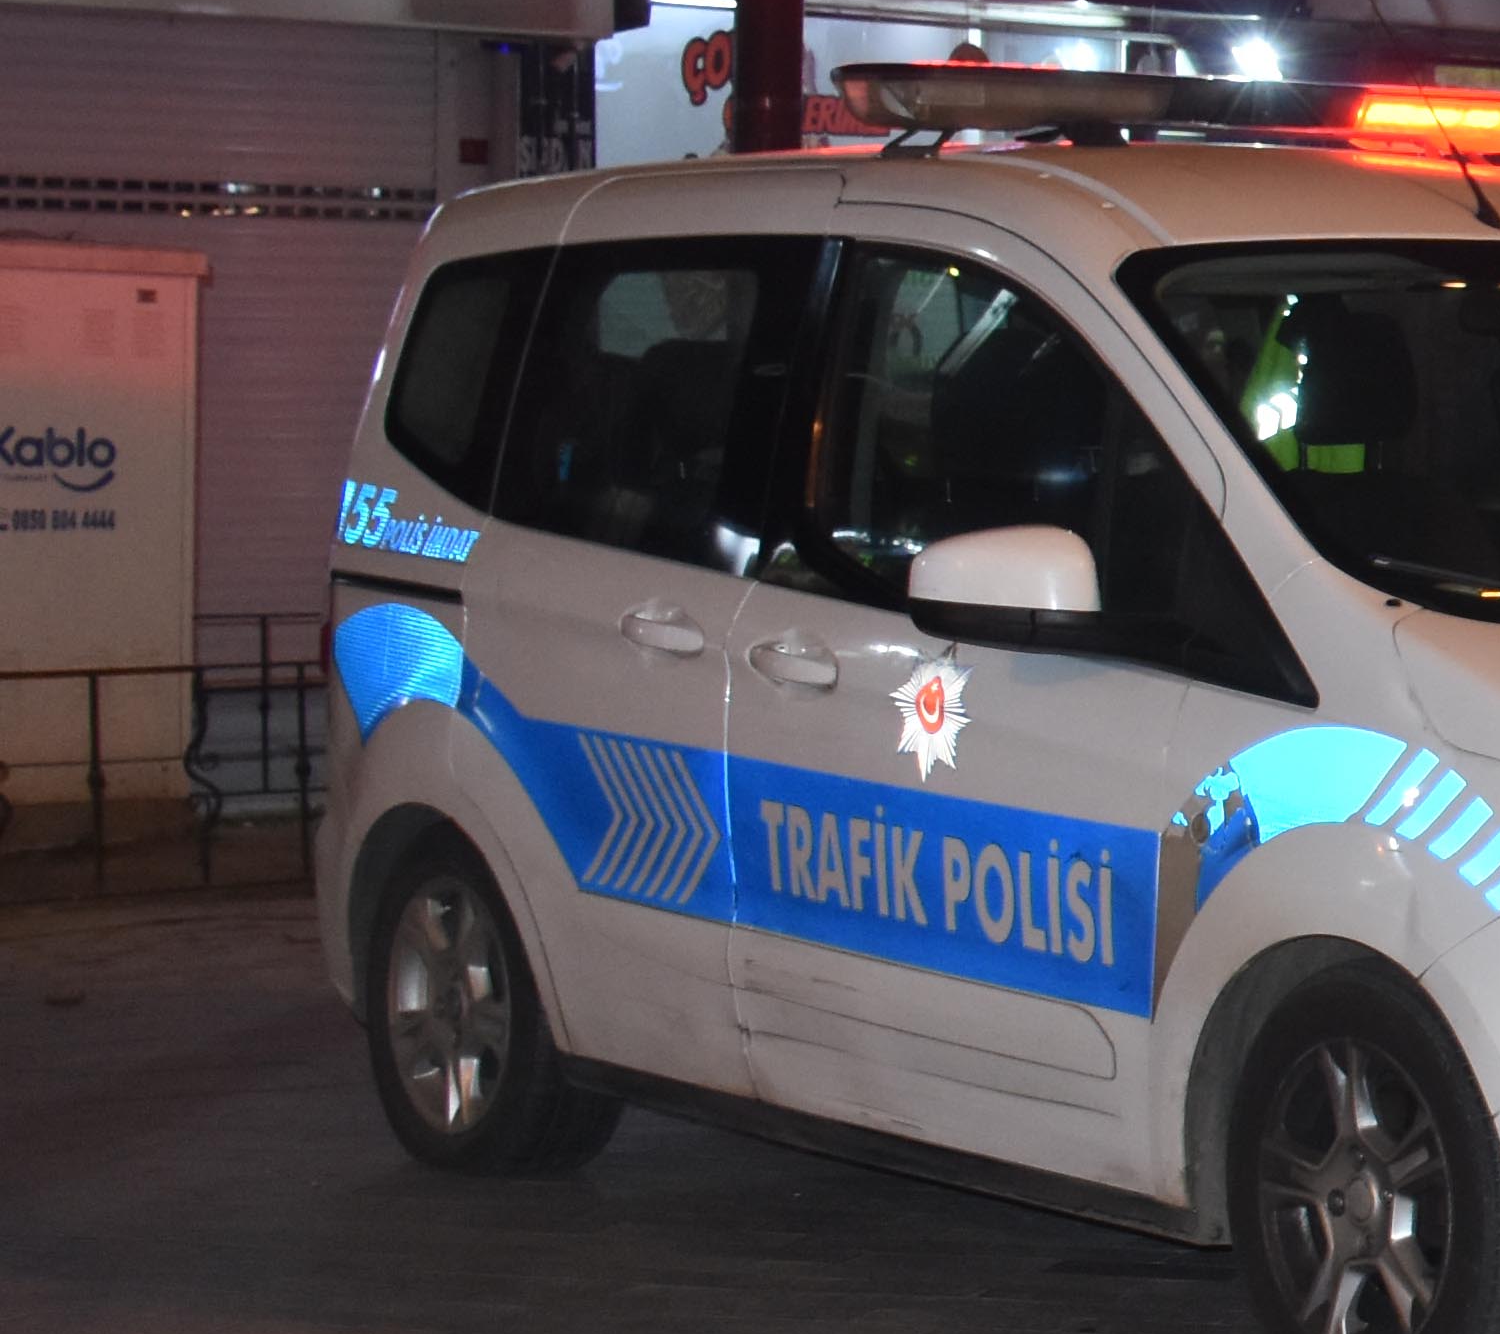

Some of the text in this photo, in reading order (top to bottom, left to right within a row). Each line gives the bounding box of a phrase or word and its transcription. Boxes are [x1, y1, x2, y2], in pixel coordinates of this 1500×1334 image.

[337, 478, 481, 563] 155 POLİS İMDAT
[759, 799, 1117, 968] TRAFİK POLİSİ
